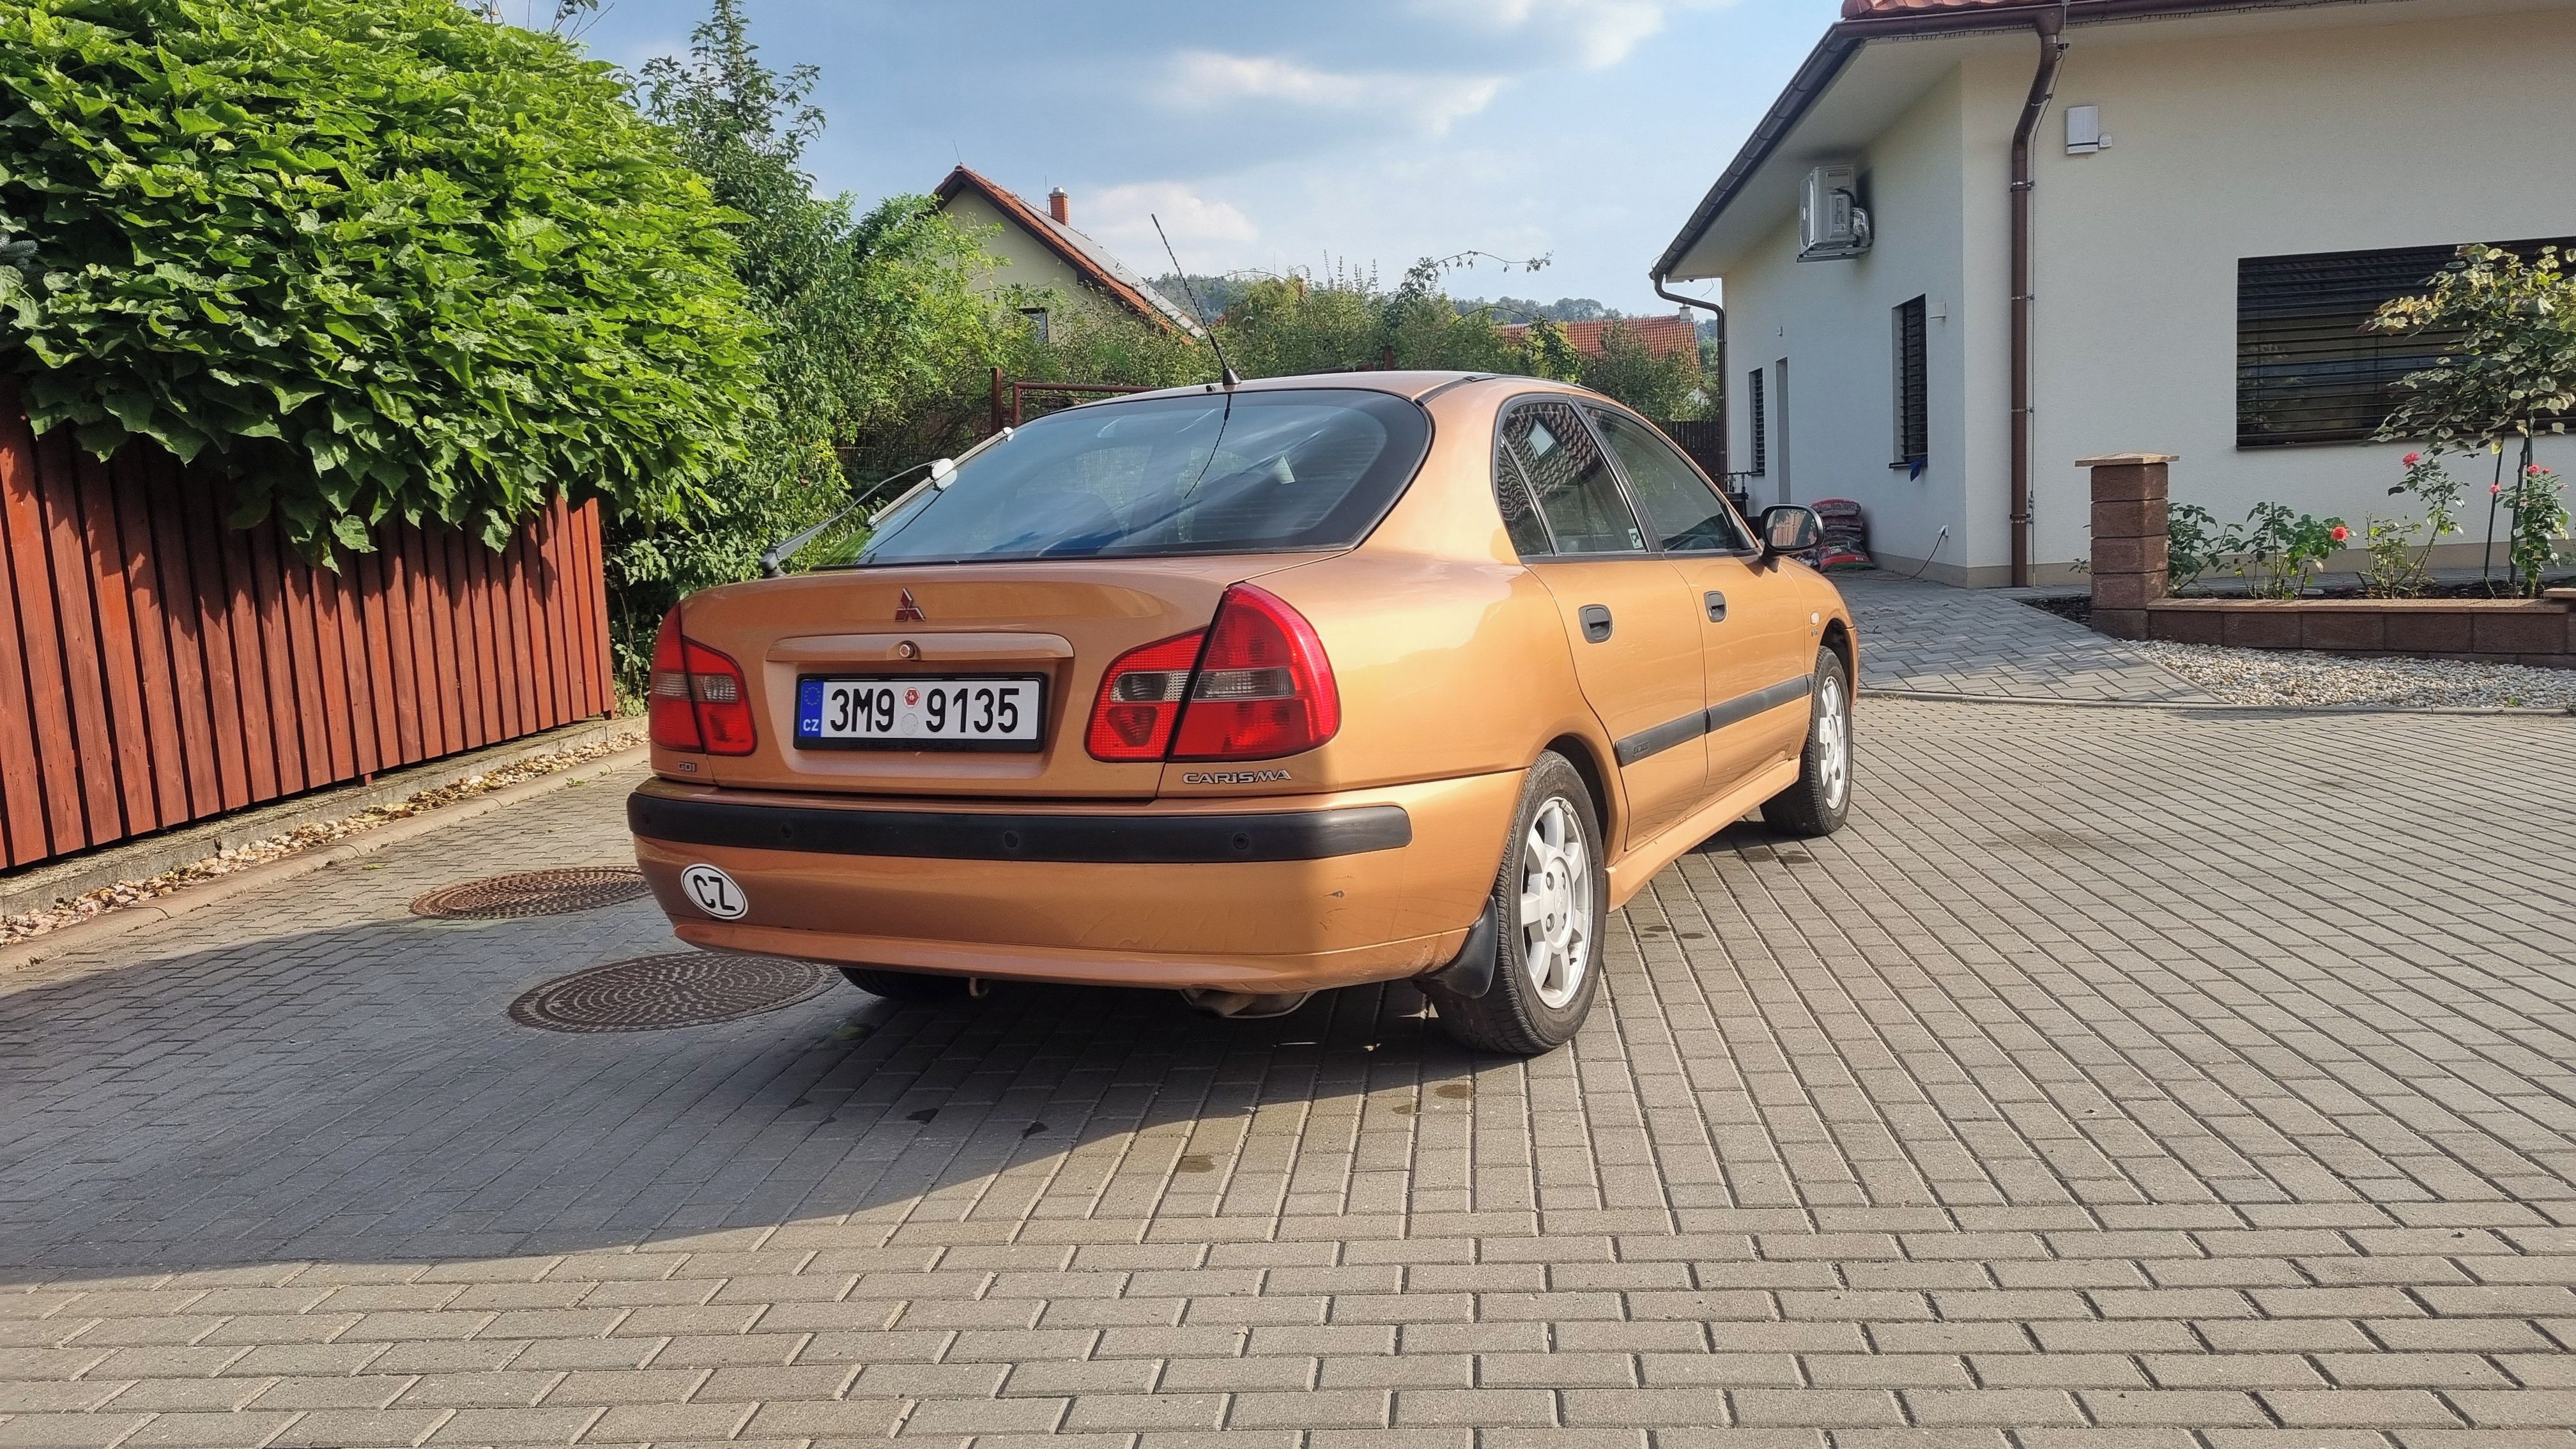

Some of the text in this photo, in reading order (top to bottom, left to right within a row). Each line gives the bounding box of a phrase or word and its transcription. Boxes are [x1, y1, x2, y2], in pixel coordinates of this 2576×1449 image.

[831, 688, 1019, 733] 3M9 9135
[803, 719, 818, 732] CZ
[678, 762, 696, 771] GDI
[1183, 769, 1292, 784] CARISMA
[693, 875, 737, 910] CZ
